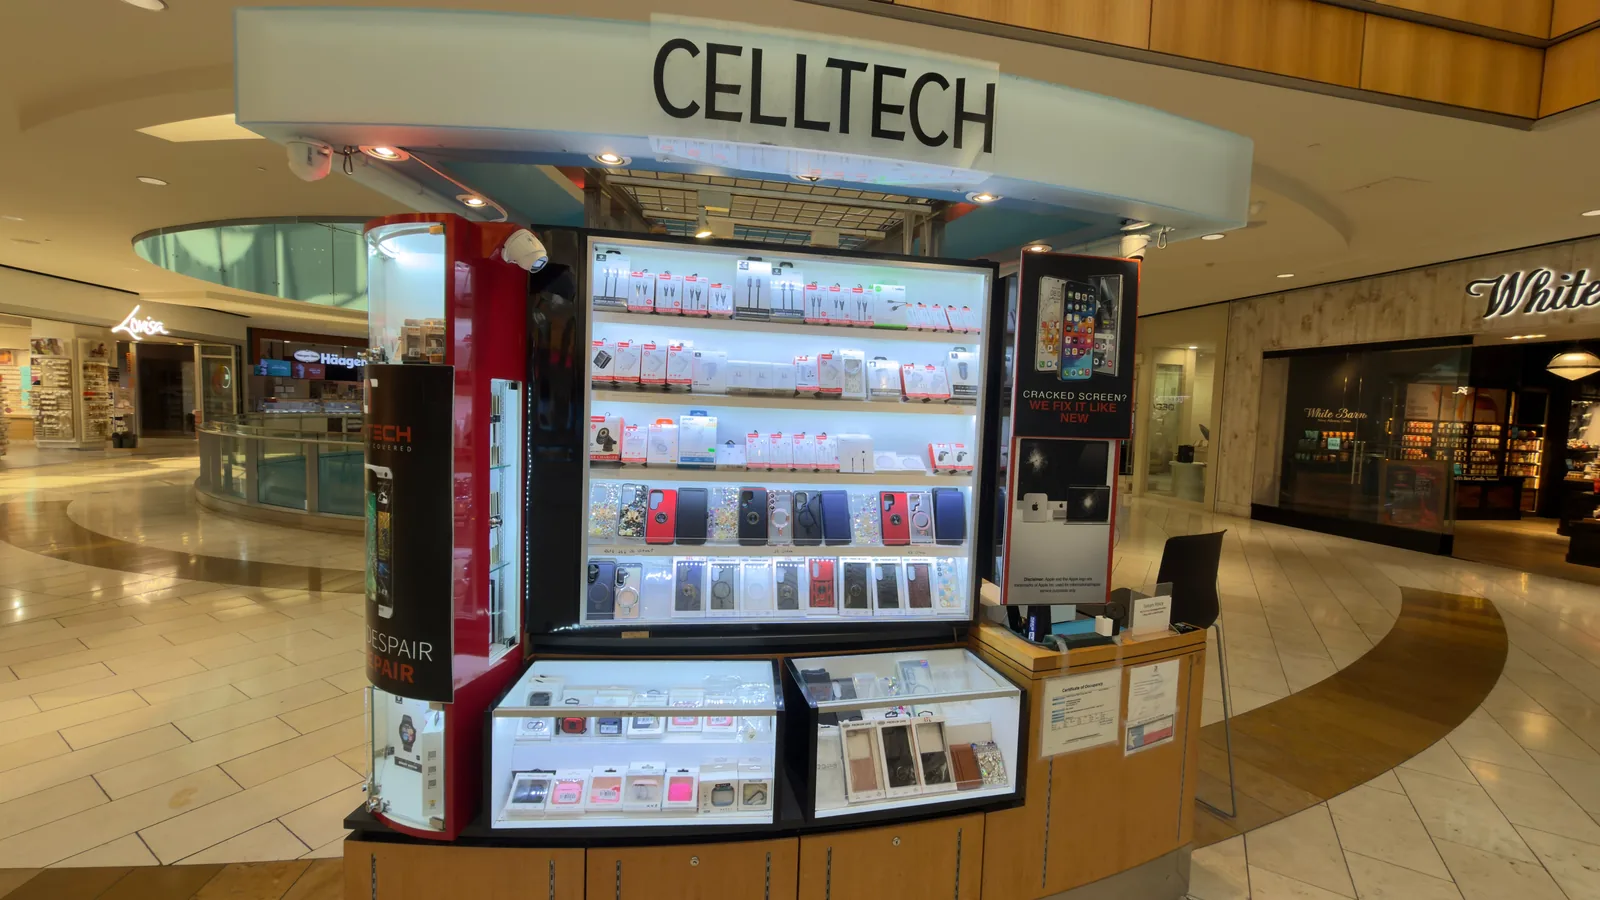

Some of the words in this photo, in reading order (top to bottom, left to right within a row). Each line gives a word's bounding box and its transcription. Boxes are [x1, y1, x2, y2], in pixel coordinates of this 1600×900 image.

[653, 38, 996, 154] CELLTECH
[1465, 267, 1600, 319] White
[1023, 390, 1075, 400] CRACKED
[1078, 392, 1128, 402] SCREEN?
[1029, 400, 1050, 411] WE
[1053, 401, 1072, 412] FIX
[1075, 402, 1086, 412] IT
[1089, 403, 1117, 413] LIKE
[1060, 413, 1089, 423] NEW
[1304, 408, 1333, 418] White
[1335, 408, 1368, 419] Barn
[367, 625, 433, 662] DESPAIR
